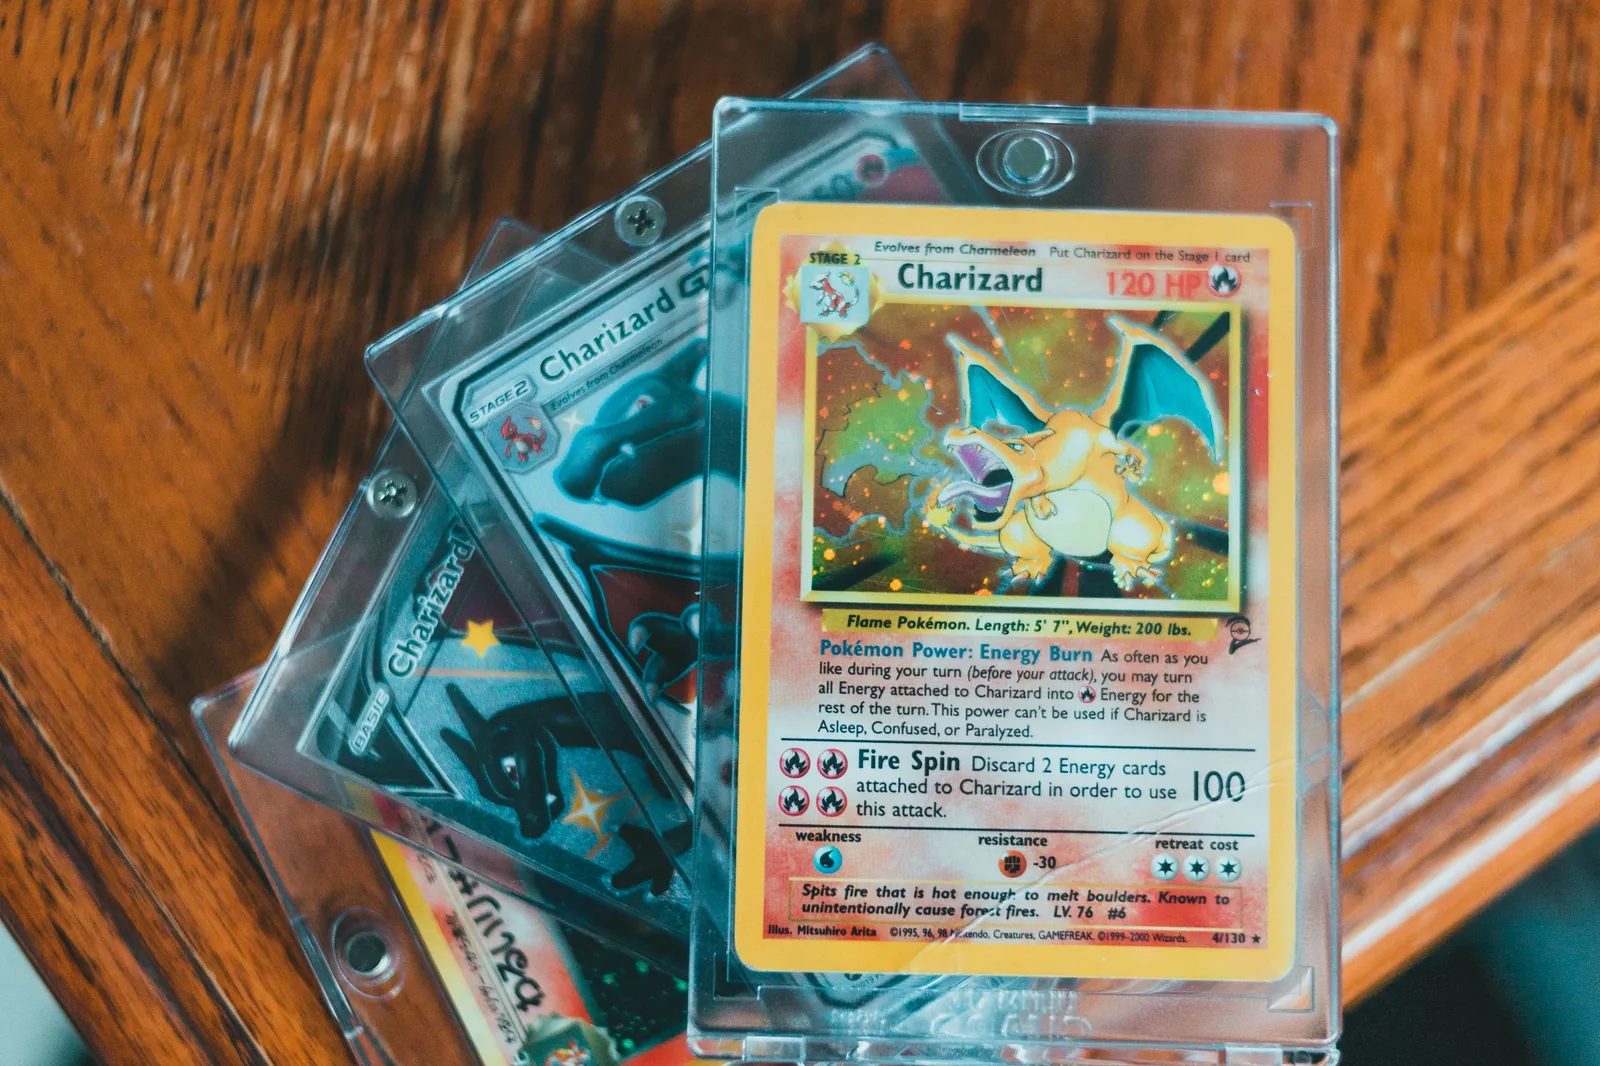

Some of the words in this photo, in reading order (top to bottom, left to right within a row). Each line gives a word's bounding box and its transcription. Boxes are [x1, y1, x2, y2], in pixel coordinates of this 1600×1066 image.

[810, 252, 848, 264] STAGE
[854, 254, 860, 265] 2
[875, 241, 920, 253] Evolves
[925, 243, 954, 255] from
[959, 244, 1036, 256] Charmeleon
[1050, 246, 1069, 257] Put
[1074, 246, 1131, 259] Charizard
[1135, 249, 1150, 260] on
[1155, 249, 1174, 261] the
[1178, 250, 1209, 264] Stage
[1224, 252, 1250, 265] card
[898, 263, 1042, 292] Charizard
[1107, 271, 1155, 297] 120
[1165, 273, 1201, 299] HP
[540, 288, 675, 381] Charizard
[551, 387, 586, 411] Evolves
[587, 371, 609, 389] from
[386, 538, 473, 677] Charizard
[847, 614, 892, 628] Flame
[898, 616, 970, 630] Pokémon.
[975, 618, 1029, 635] Length:
[1076, 621, 1131, 638] Weight:
[1136, 622, 1162, 635] 200
[1168, 623, 1191, 636] lbs.
[821, 639, 903, 657] Pokémon
[913, 642, 972, 659] Power:
[980, 644, 1040, 664] Energy
[1050, 645, 1092, 662] Burn
[1101, 649, 1118, 662] As
[1124, 650, 1159, 663] often
[1165, 654, 1178, 664] as
[1184, 655, 1208, 668] you
[820, 661, 842, 675] like
[848, 662, 891, 680] during
[896, 667, 927, 680] your
[933, 667, 961, 677] turn
[968, 665, 1012, 682] (before
[1017, 670, 1044, 683] your
[1049, 668, 1096, 684] attack),
[1101, 673, 1125, 685] you
[1132, 673, 1158, 686] may
[1164, 673, 1192, 683] turn
[819, 681, 833, 694] all
[839, 681, 885, 699] Energy
[891, 683, 949, 697] attached
[955, 687, 969, 697] to
[975, 684, 1041, 699] Charizard
[1048, 690, 1074, 700] into
[1101, 688, 1147, 705] Energy
[1152, 689, 1172, 702] for
[1177, 690, 1199, 703] the
[351, 690, 390, 749] BASIC
[819, 704, 845, 714] rest
[850, 701, 865, 714] of
[869, 702, 891, 715] the
[896, 705, 929, 715] turn.
[931, 703, 959, 716] This
[965, 708, 1009, 720] power
[1052, 706, 1068, 719] be
[1074, 708, 1105, 720] used
[1111, 707, 1119, 720] if
[1124, 707, 1190, 722] Charizard
[1197, 710, 1206, 722] is
[818, 720, 867, 737] Asleep,
[872, 721, 940, 737] Confused,
[944, 727, 960, 736] or
[966, 723, 1033, 741] Paralyzed.
[859, 749, 900, 769] Fire
[912, 750, 959, 776] Spin
[972, 756, 1035, 772] Discard
[1043, 757, 1051, 773] 2
[1060, 758, 1115, 779] Energy
[1123, 760, 1166, 776] cards
[857, 778, 927, 794] attached
[935, 782, 952, 794] to
[960, 779, 1041, 796] Charizard
[1049, 782, 1062, 796] in
[1070, 782, 1117, 798] order
[1124, 787, 1142, 798] to
[1150, 788, 1176, 799] use
[1194, 771, 1246, 802] 100
[856, 800, 885, 816] this
[892, 802, 946, 817] attack.
[796, 829, 861, 842] weakness
[979, 835, 1047, 846] resistance
[1156, 839, 1203, 850] retreat
[1210, 841, 1238, 850] cost
[1033, 856, 1056, 869] -30
[802, 883, 836, 900] Spits
[844, 885, 868, 900] fire
[876, 886, 906, 898] that
[914, 887, 924, 899] is
[932, 886, 956, 899] hot
[964, 888, 1016, 903] enough
[1025, 891, 1039, 900] to
[1047, 889, 1079, 901] melt
[1087, 890, 1150, 903] boulders.
[1158, 891, 1207, 904] Known
[1215, 895, 1230, 905] to
[802, 901, 909, 918] unintentionally
[915, 906, 955, 916] cause
[1006, 904, 1039, 920] fires.
[1054, 905, 1072, 918] LV.
[1077, 906, 1093, 918] 76
[1108, 907, 1126, 920] #6
[768, 924, 792, 935] Illus.
[797, 925, 847, 936] Mitsuhiro
[851, 926, 876, 936] Arita
[923, 928, 933, 938] 96,
[937, 928, 948, 938] 98
[1212, 933, 1245, 944] 4/130
